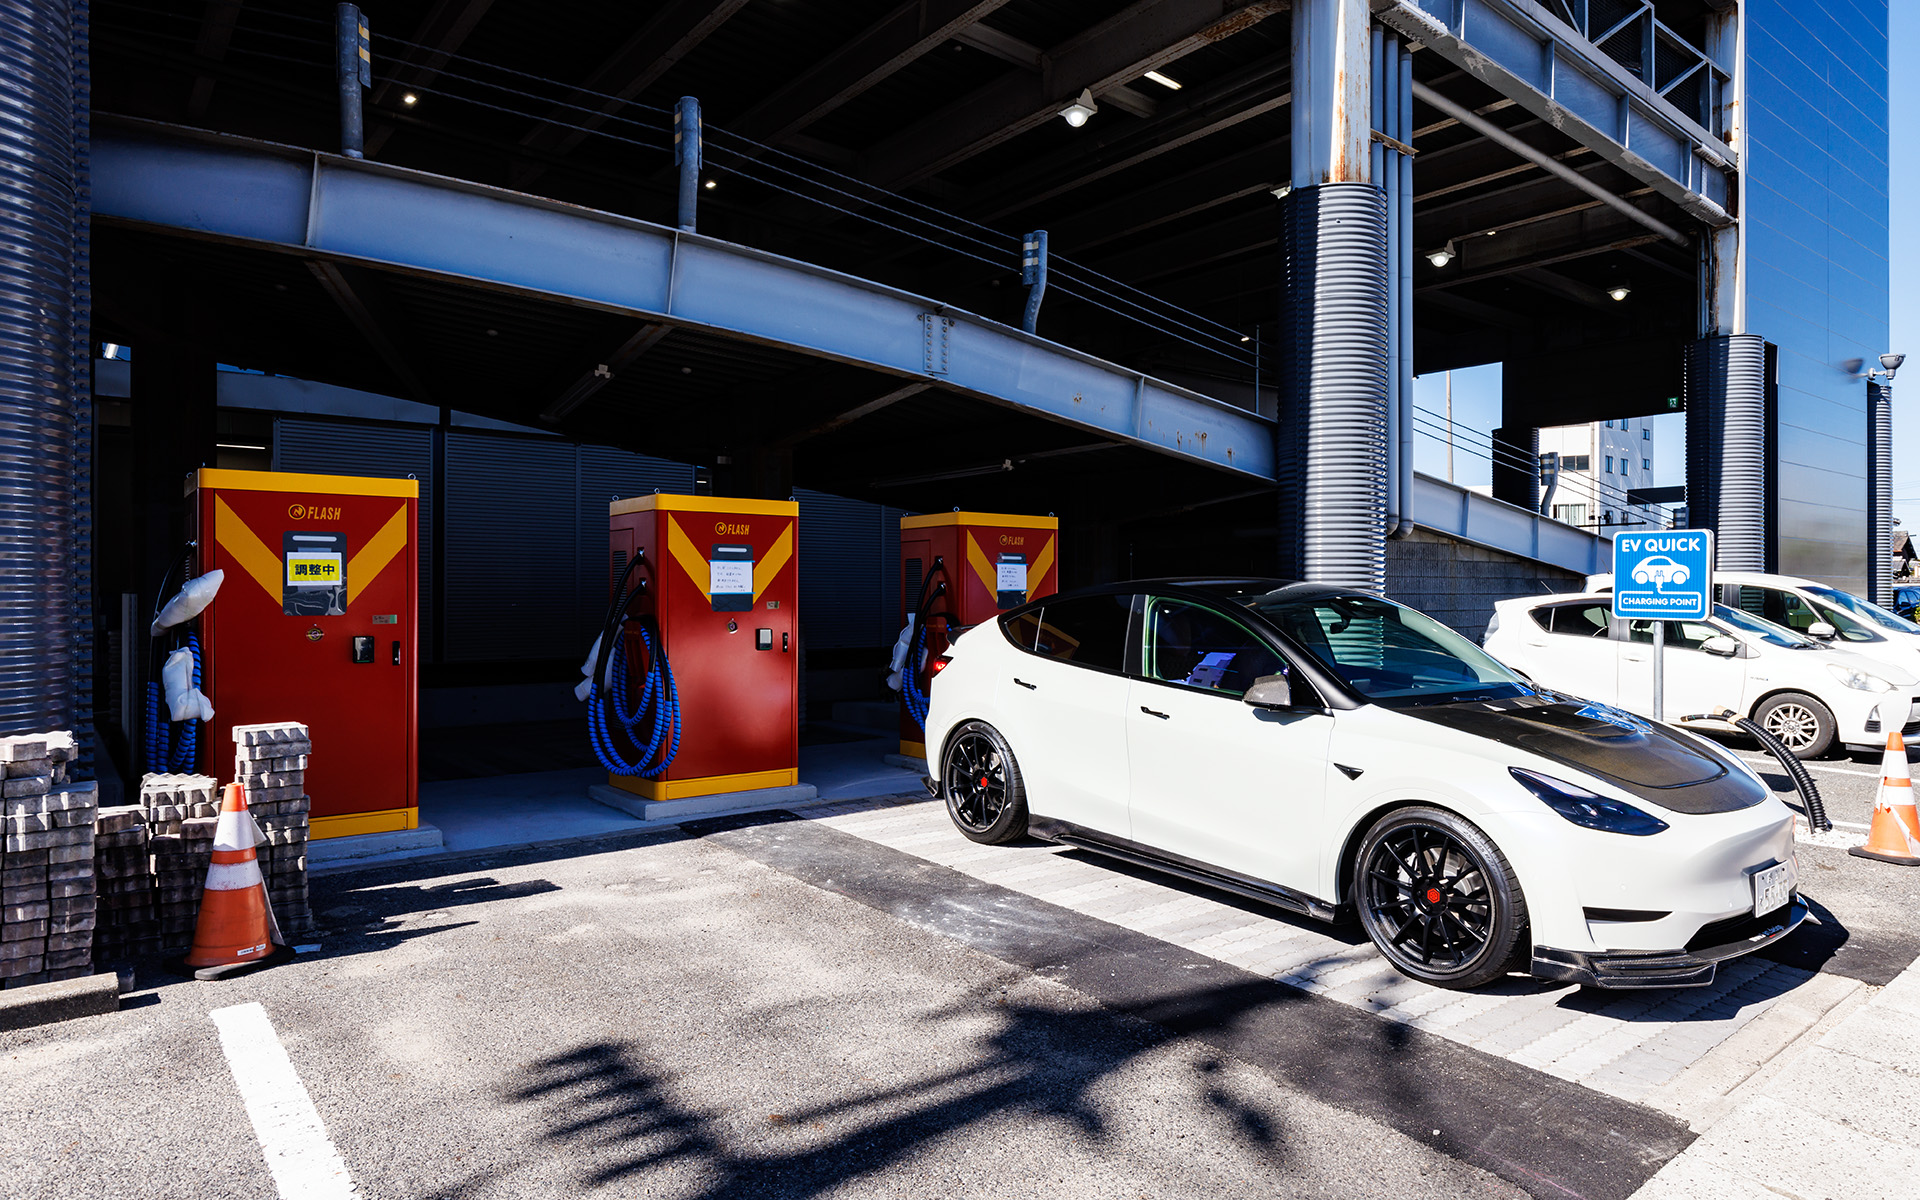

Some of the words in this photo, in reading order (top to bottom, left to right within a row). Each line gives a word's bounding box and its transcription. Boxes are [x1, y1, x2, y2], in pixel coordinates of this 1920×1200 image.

[307, 506, 341, 520] FLASH
[727, 524, 749, 535] FLASH
[1008, 536, 1024, 545] FLASH
[1621, 539, 1641, 552] EV
[1644, 537, 1701, 552] QUICK
[294, 564, 335, 576] 調整中
[1622, 597, 1668, 606] CHARGING
[1669, 598, 1697, 606] POINT
